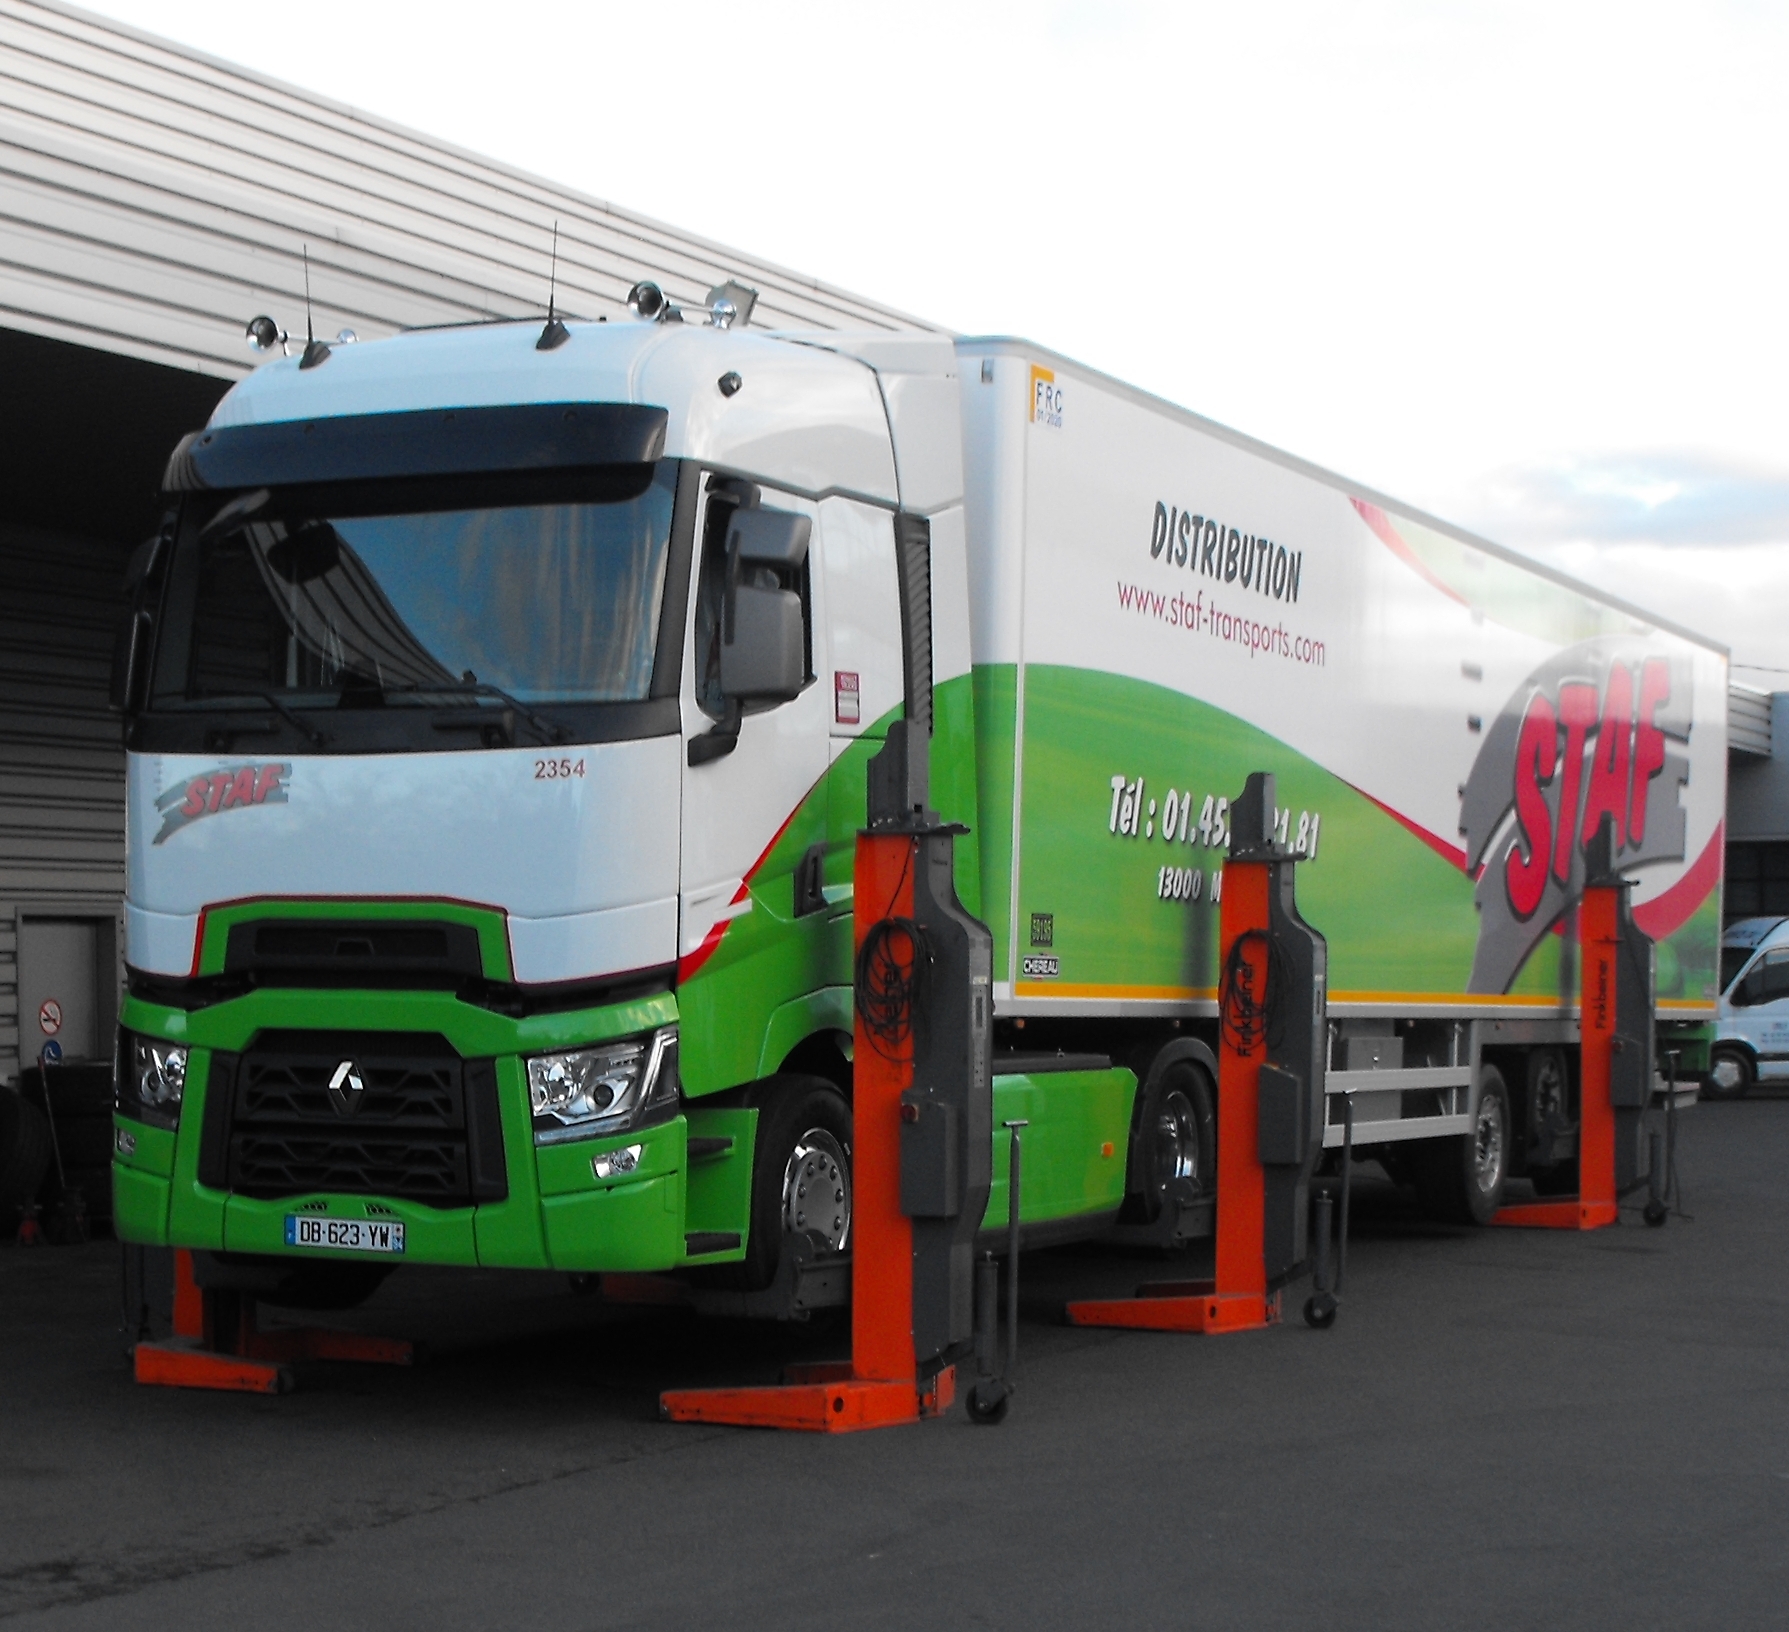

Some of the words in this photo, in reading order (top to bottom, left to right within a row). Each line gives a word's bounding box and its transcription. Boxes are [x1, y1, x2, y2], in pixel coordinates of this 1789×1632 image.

[1150, 500, 1302, 604] DISTRIBUTION
[1117, 580, 1326, 667] www.staf-transports.com
[179, 762, 286, 819] STAF
[534, 759, 586, 779] 2354
[1503, 654, 1672, 922] STAF
[1109, 774, 1145, 836] Tél
[1157, 865, 1203, 900] 13000
[1023, 957, 1059, 976] CHEREAU
